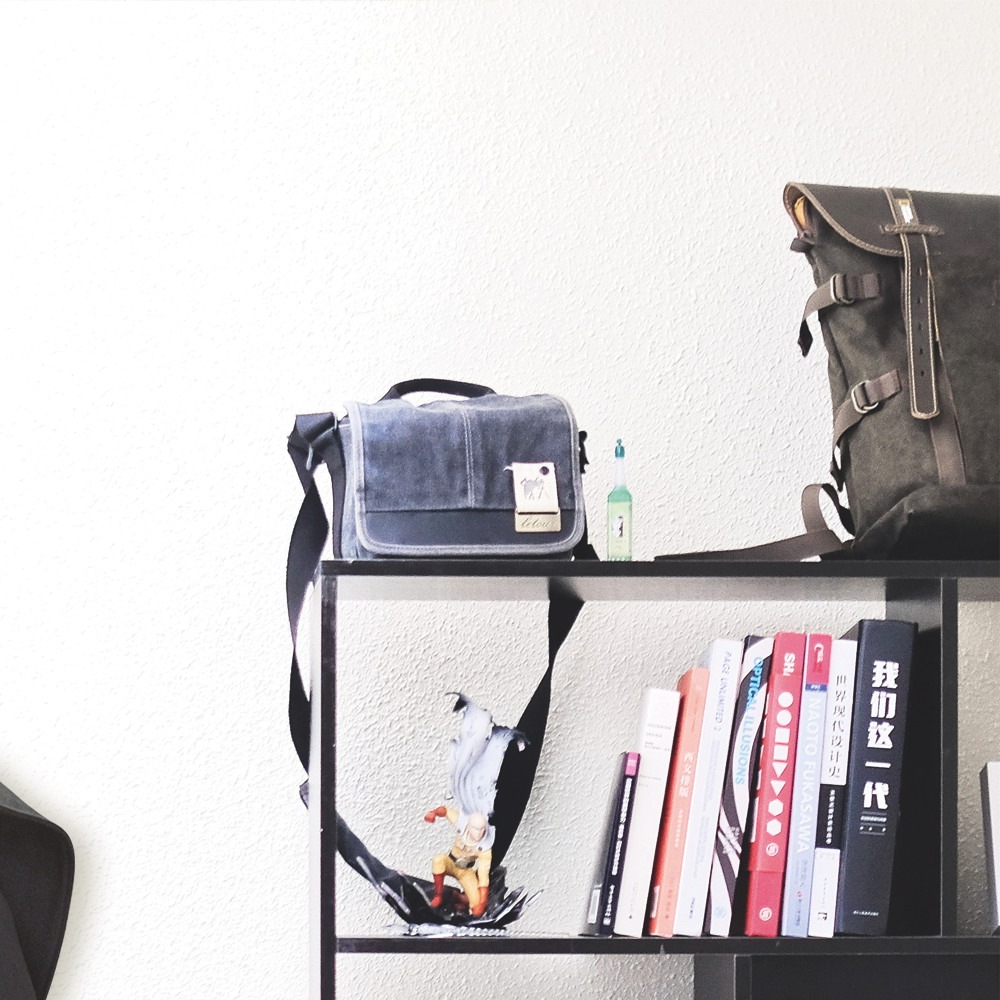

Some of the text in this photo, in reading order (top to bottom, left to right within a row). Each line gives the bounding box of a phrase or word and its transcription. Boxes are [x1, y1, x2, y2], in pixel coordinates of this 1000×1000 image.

[735, 656, 764, 785] OPTICAL ILLUSIONS
[804, 697, 820, 756] NAOTO
[828, 674, 847, 778] 世界现代设计史
[863, 660, 900, 810] 我们这一代
[797, 761, 817, 854] FUKASAWA
